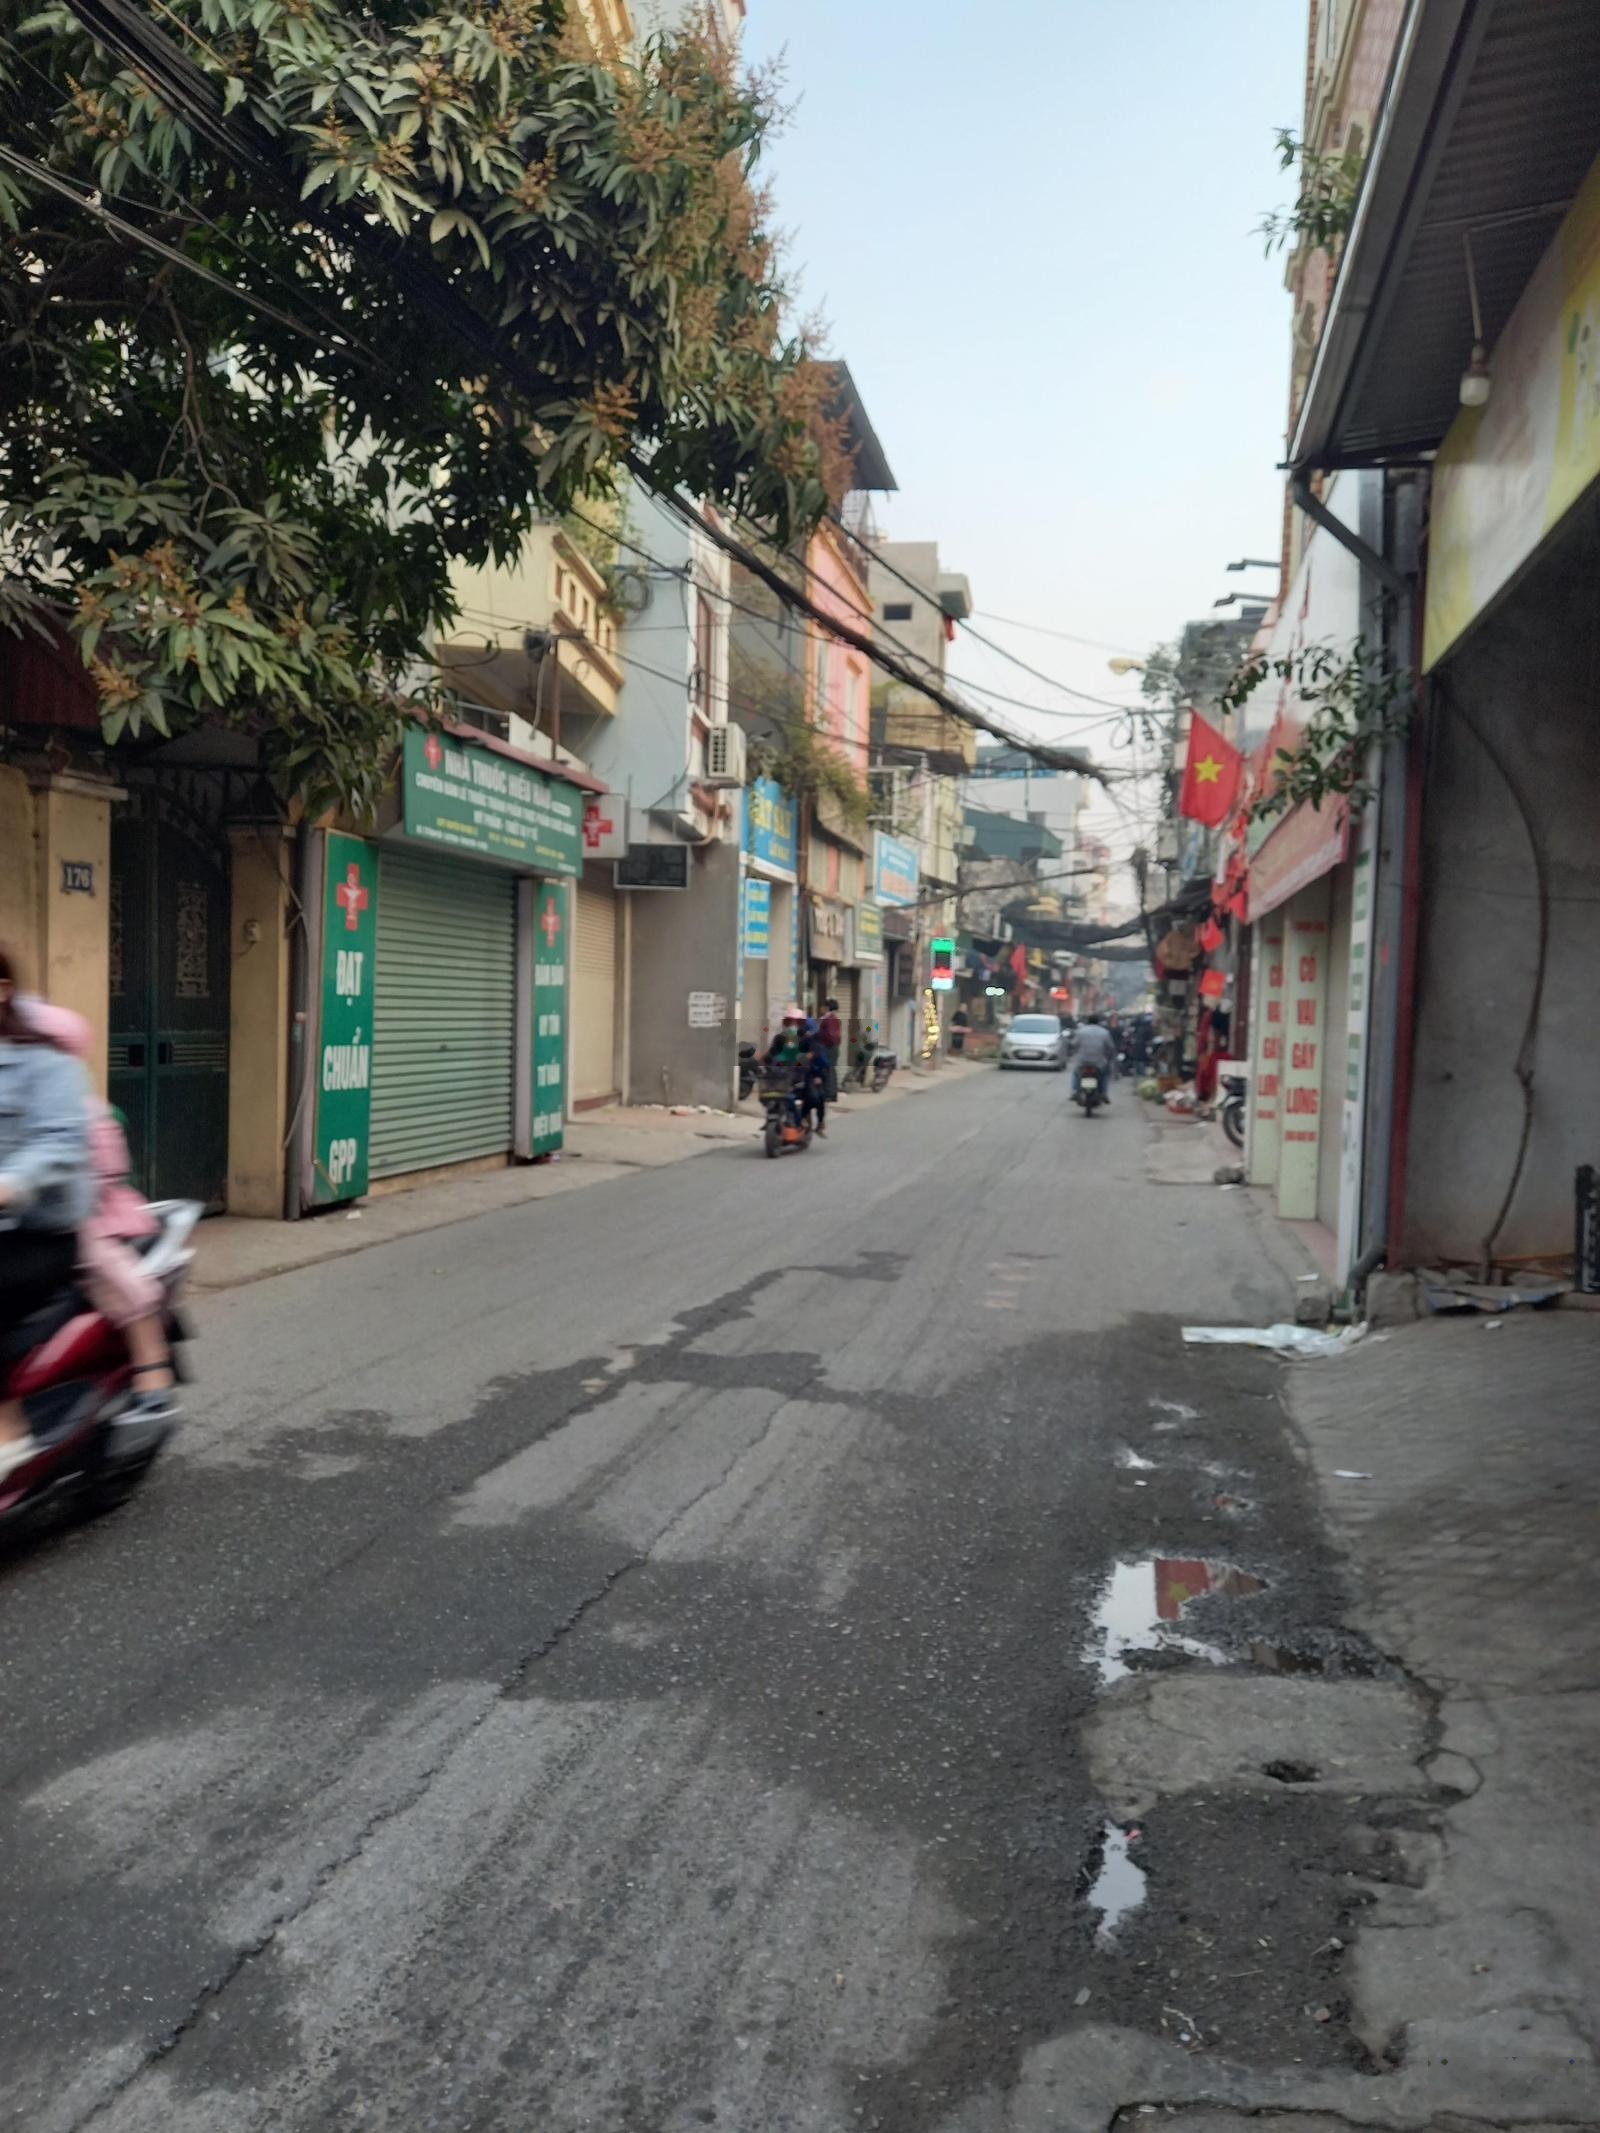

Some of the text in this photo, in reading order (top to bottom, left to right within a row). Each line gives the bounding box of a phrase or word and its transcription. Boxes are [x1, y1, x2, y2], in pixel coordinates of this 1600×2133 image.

[336, 950, 364, 1006] ĐẠT
[323, 1026, 369, 1091] CHUẨN
[1286, 1086, 1319, 1114] LƯNG
[329, 1138, 357, 1184] GPP
